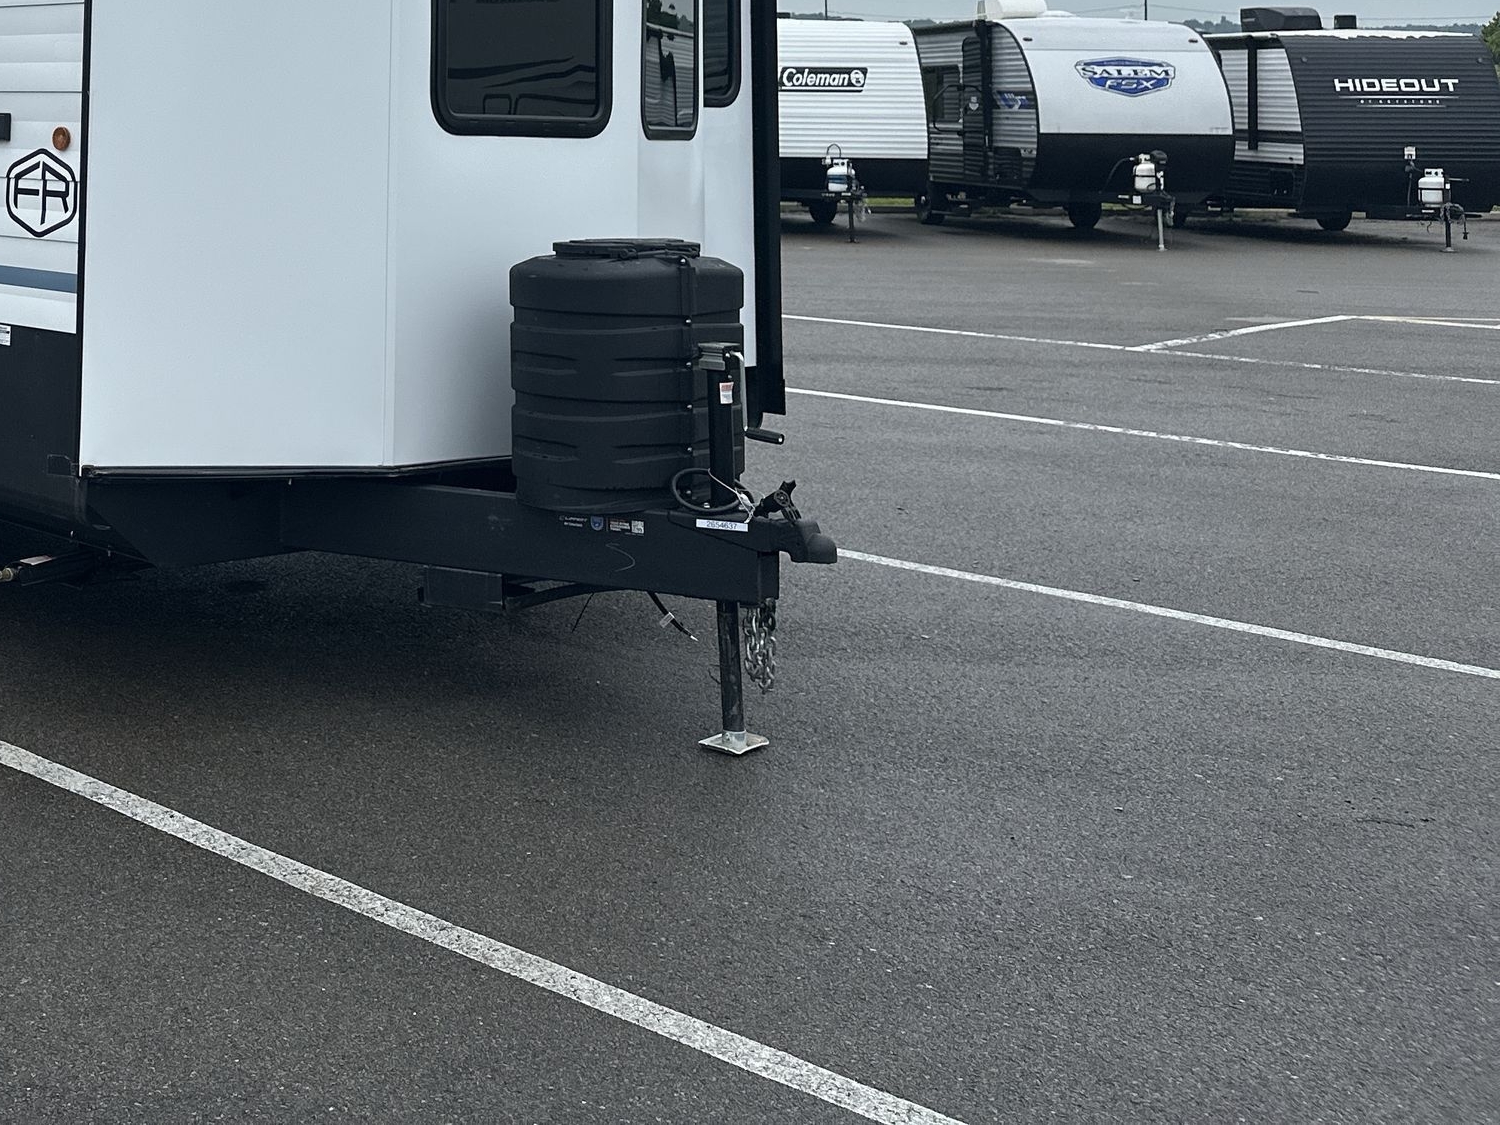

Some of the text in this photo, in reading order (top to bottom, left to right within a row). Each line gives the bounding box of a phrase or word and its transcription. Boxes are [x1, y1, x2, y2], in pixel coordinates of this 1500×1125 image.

[782, 68, 850, 86] Coleman
[1081, 65, 1173, 78] SALEM
[1105, 79, 1157, 89] FSX
[1333, 78, 1459, 92] HIDEOUT
